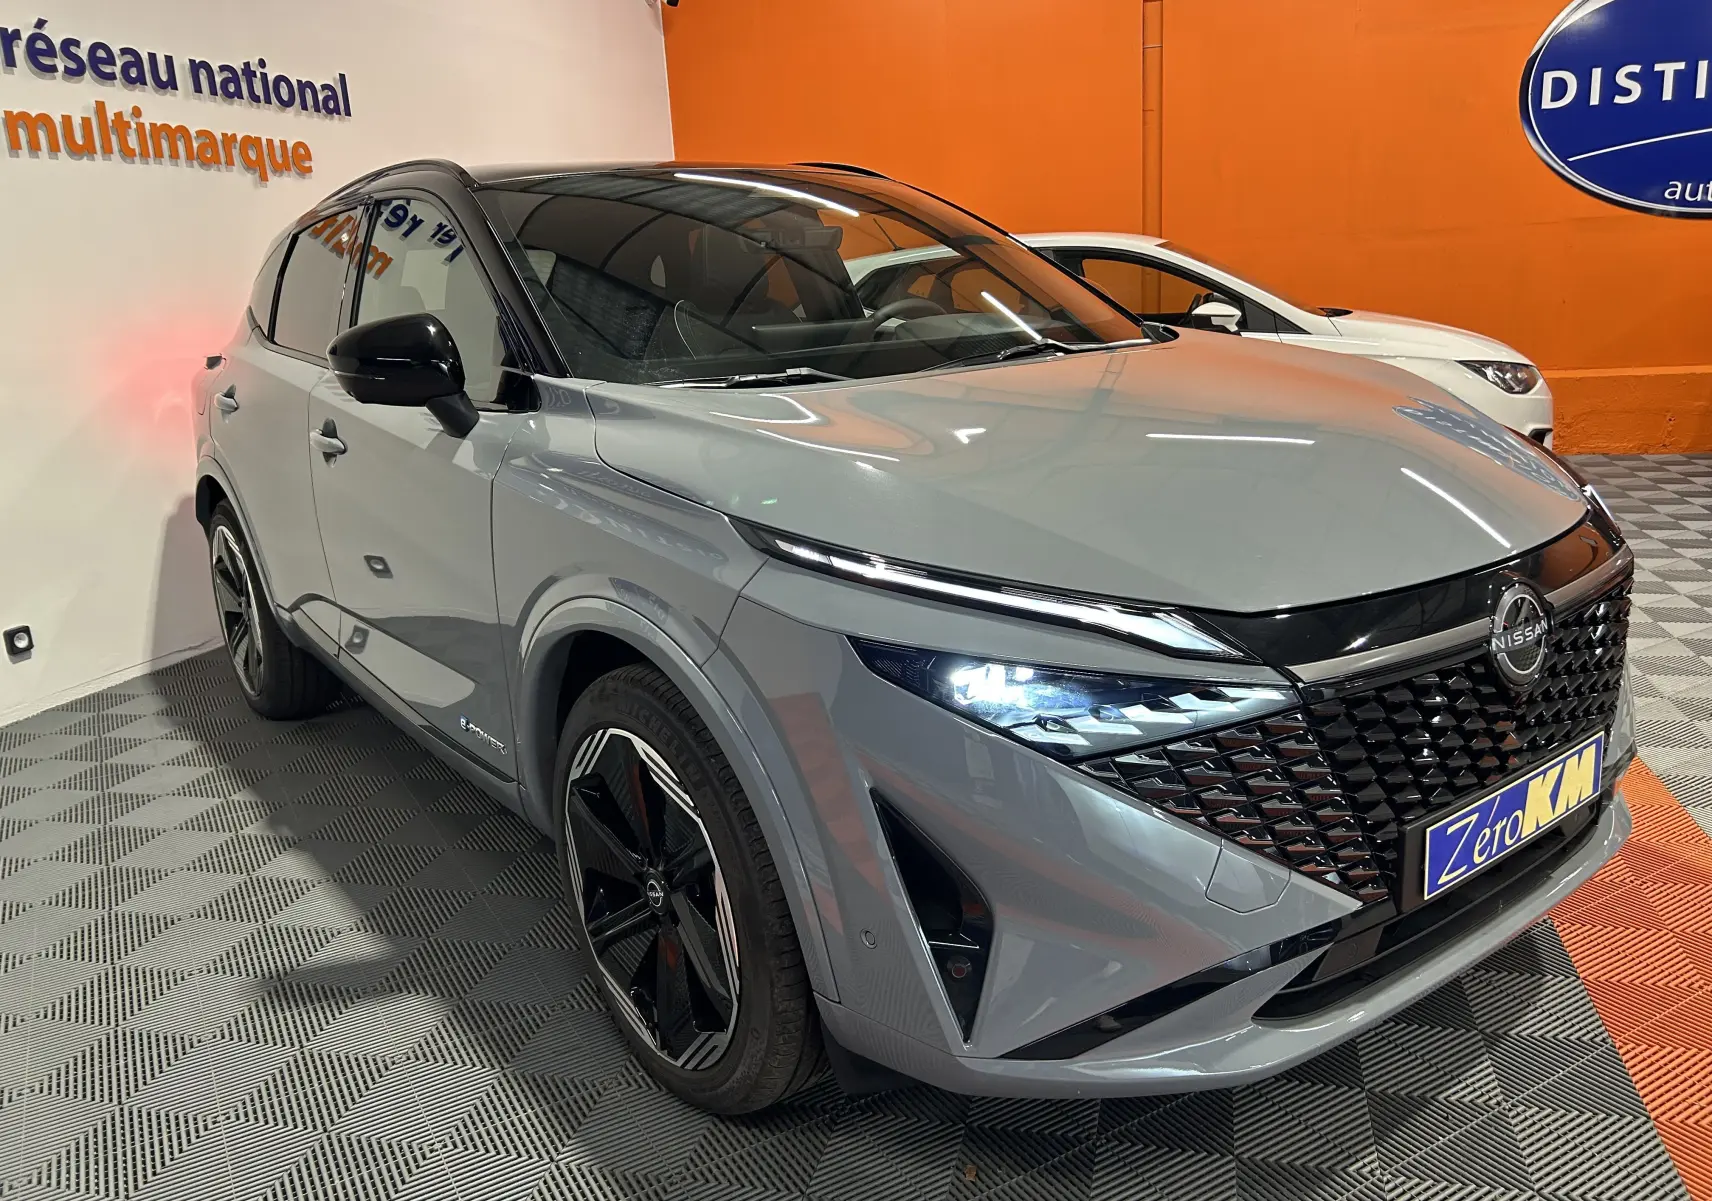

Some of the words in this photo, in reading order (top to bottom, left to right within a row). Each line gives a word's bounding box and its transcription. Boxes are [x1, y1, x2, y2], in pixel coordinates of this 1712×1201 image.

[0, 19, 178, 91] réseau
[191, 57, 352, 117] national
[1541, 60, 1709, 109] DISTI
[4, 101, 313, 182] multimarque
[1491, 617, 1548, 650] NISSAN
